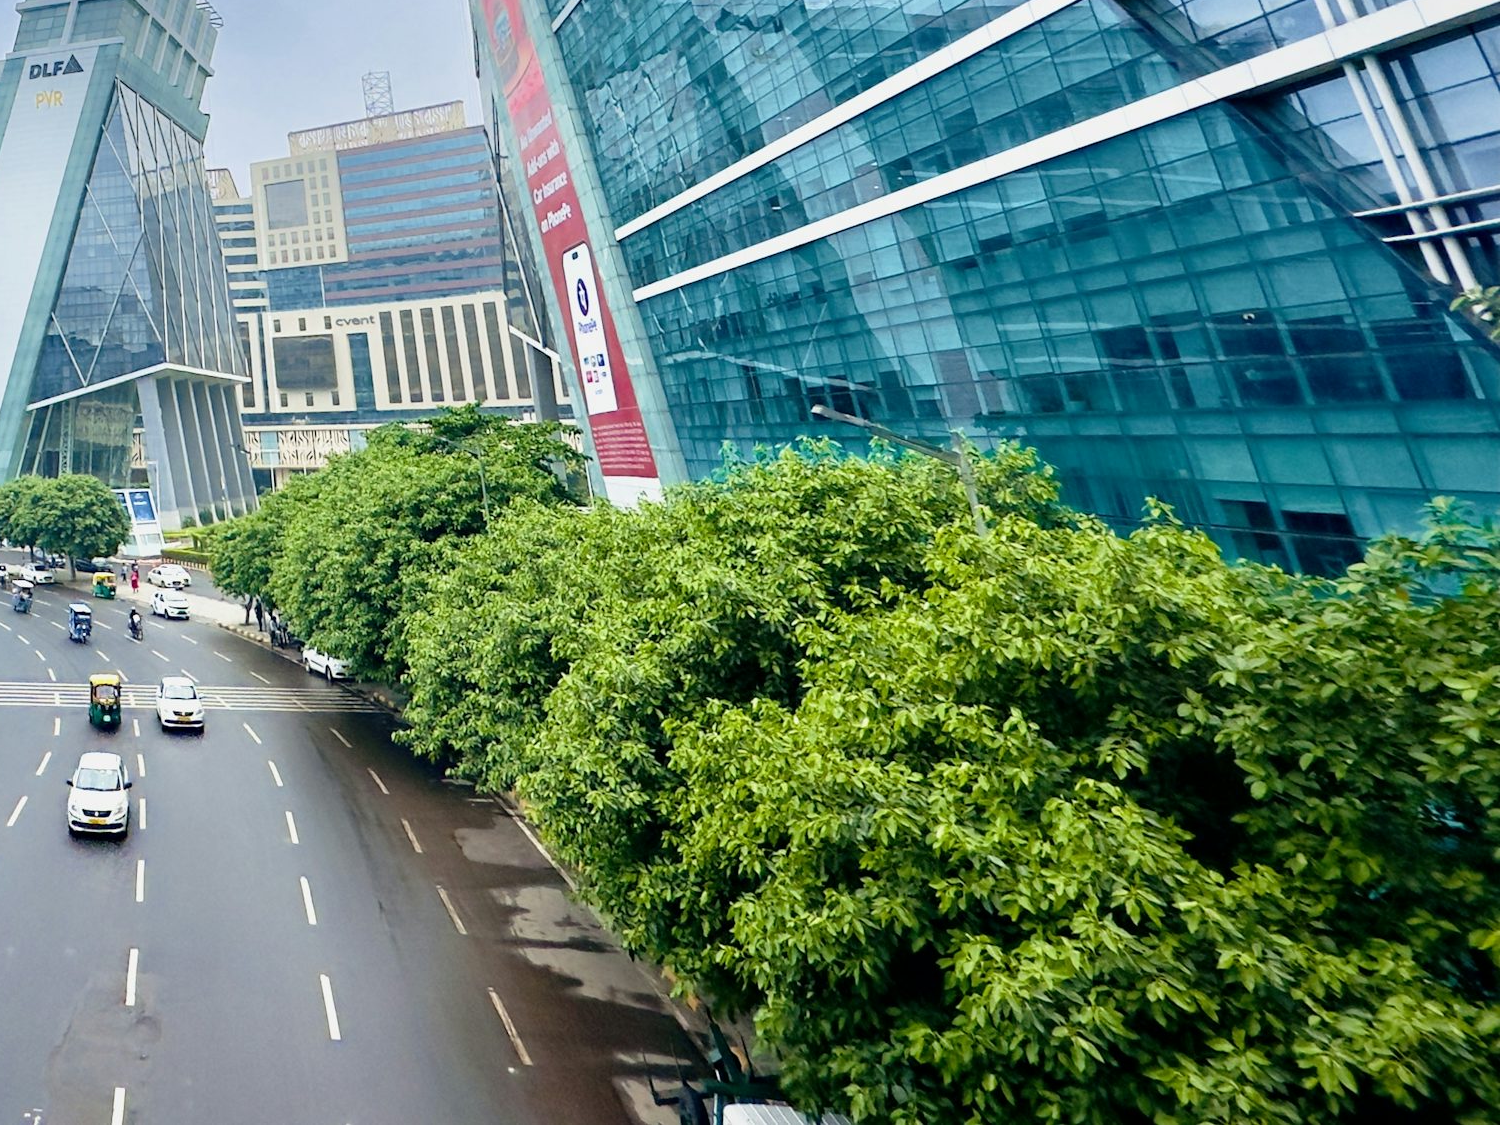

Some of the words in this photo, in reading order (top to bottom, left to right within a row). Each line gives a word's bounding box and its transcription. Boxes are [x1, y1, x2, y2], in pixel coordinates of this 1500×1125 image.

[29, 60, 64, 80] DLF
[35, 90, 63, 109] PVR
[546, 138, 560, 161] with
[533, 187, 543, 206] Car
[540, 219, 549, 234] on
[547, 202, 572, 229] PhonePe
[335, 315, 376, 326] cvent
